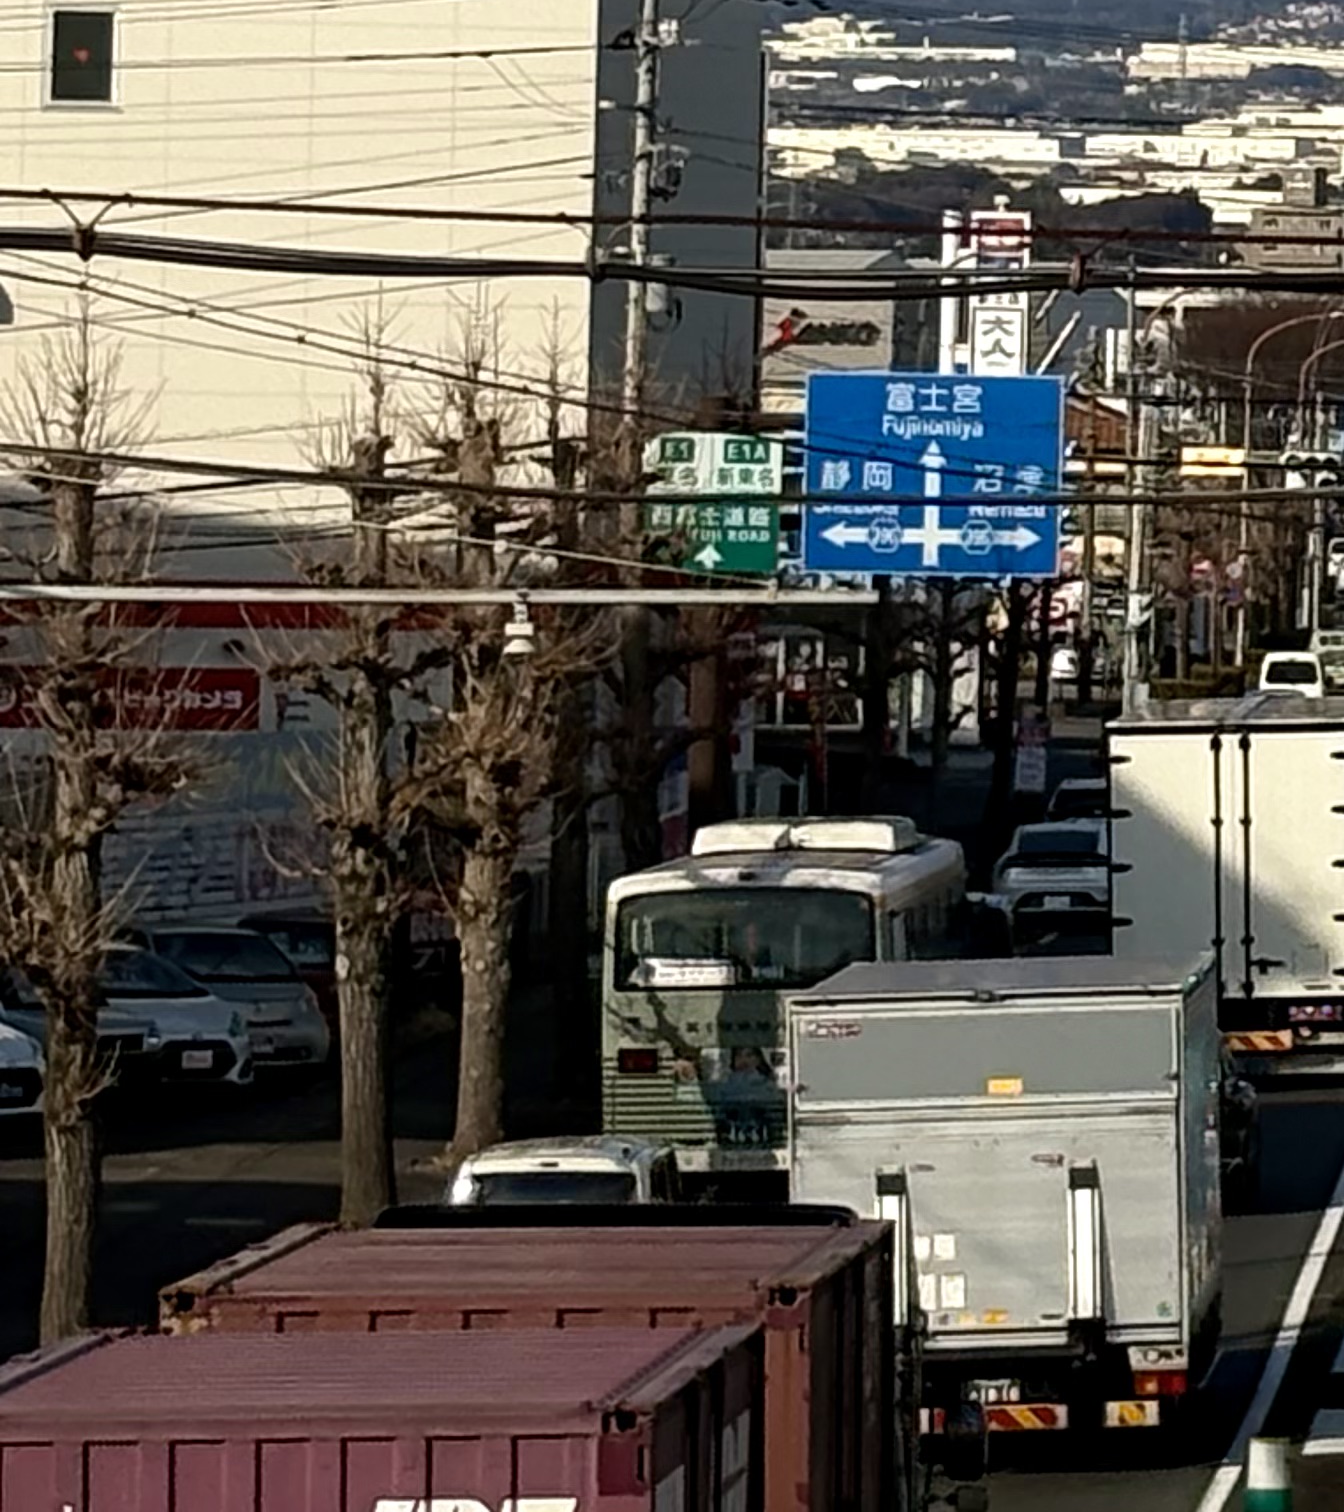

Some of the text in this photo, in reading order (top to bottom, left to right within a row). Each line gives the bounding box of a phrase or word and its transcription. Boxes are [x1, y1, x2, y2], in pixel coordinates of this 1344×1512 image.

[886, 383, 983, 413] 富士宮
[882, 414, 985, 441] Fujinomiya
[727, 442, 767, 461] E1A
[821, 460, 893, 491] 静岡
[727, 529, 771, 543] ROAD
